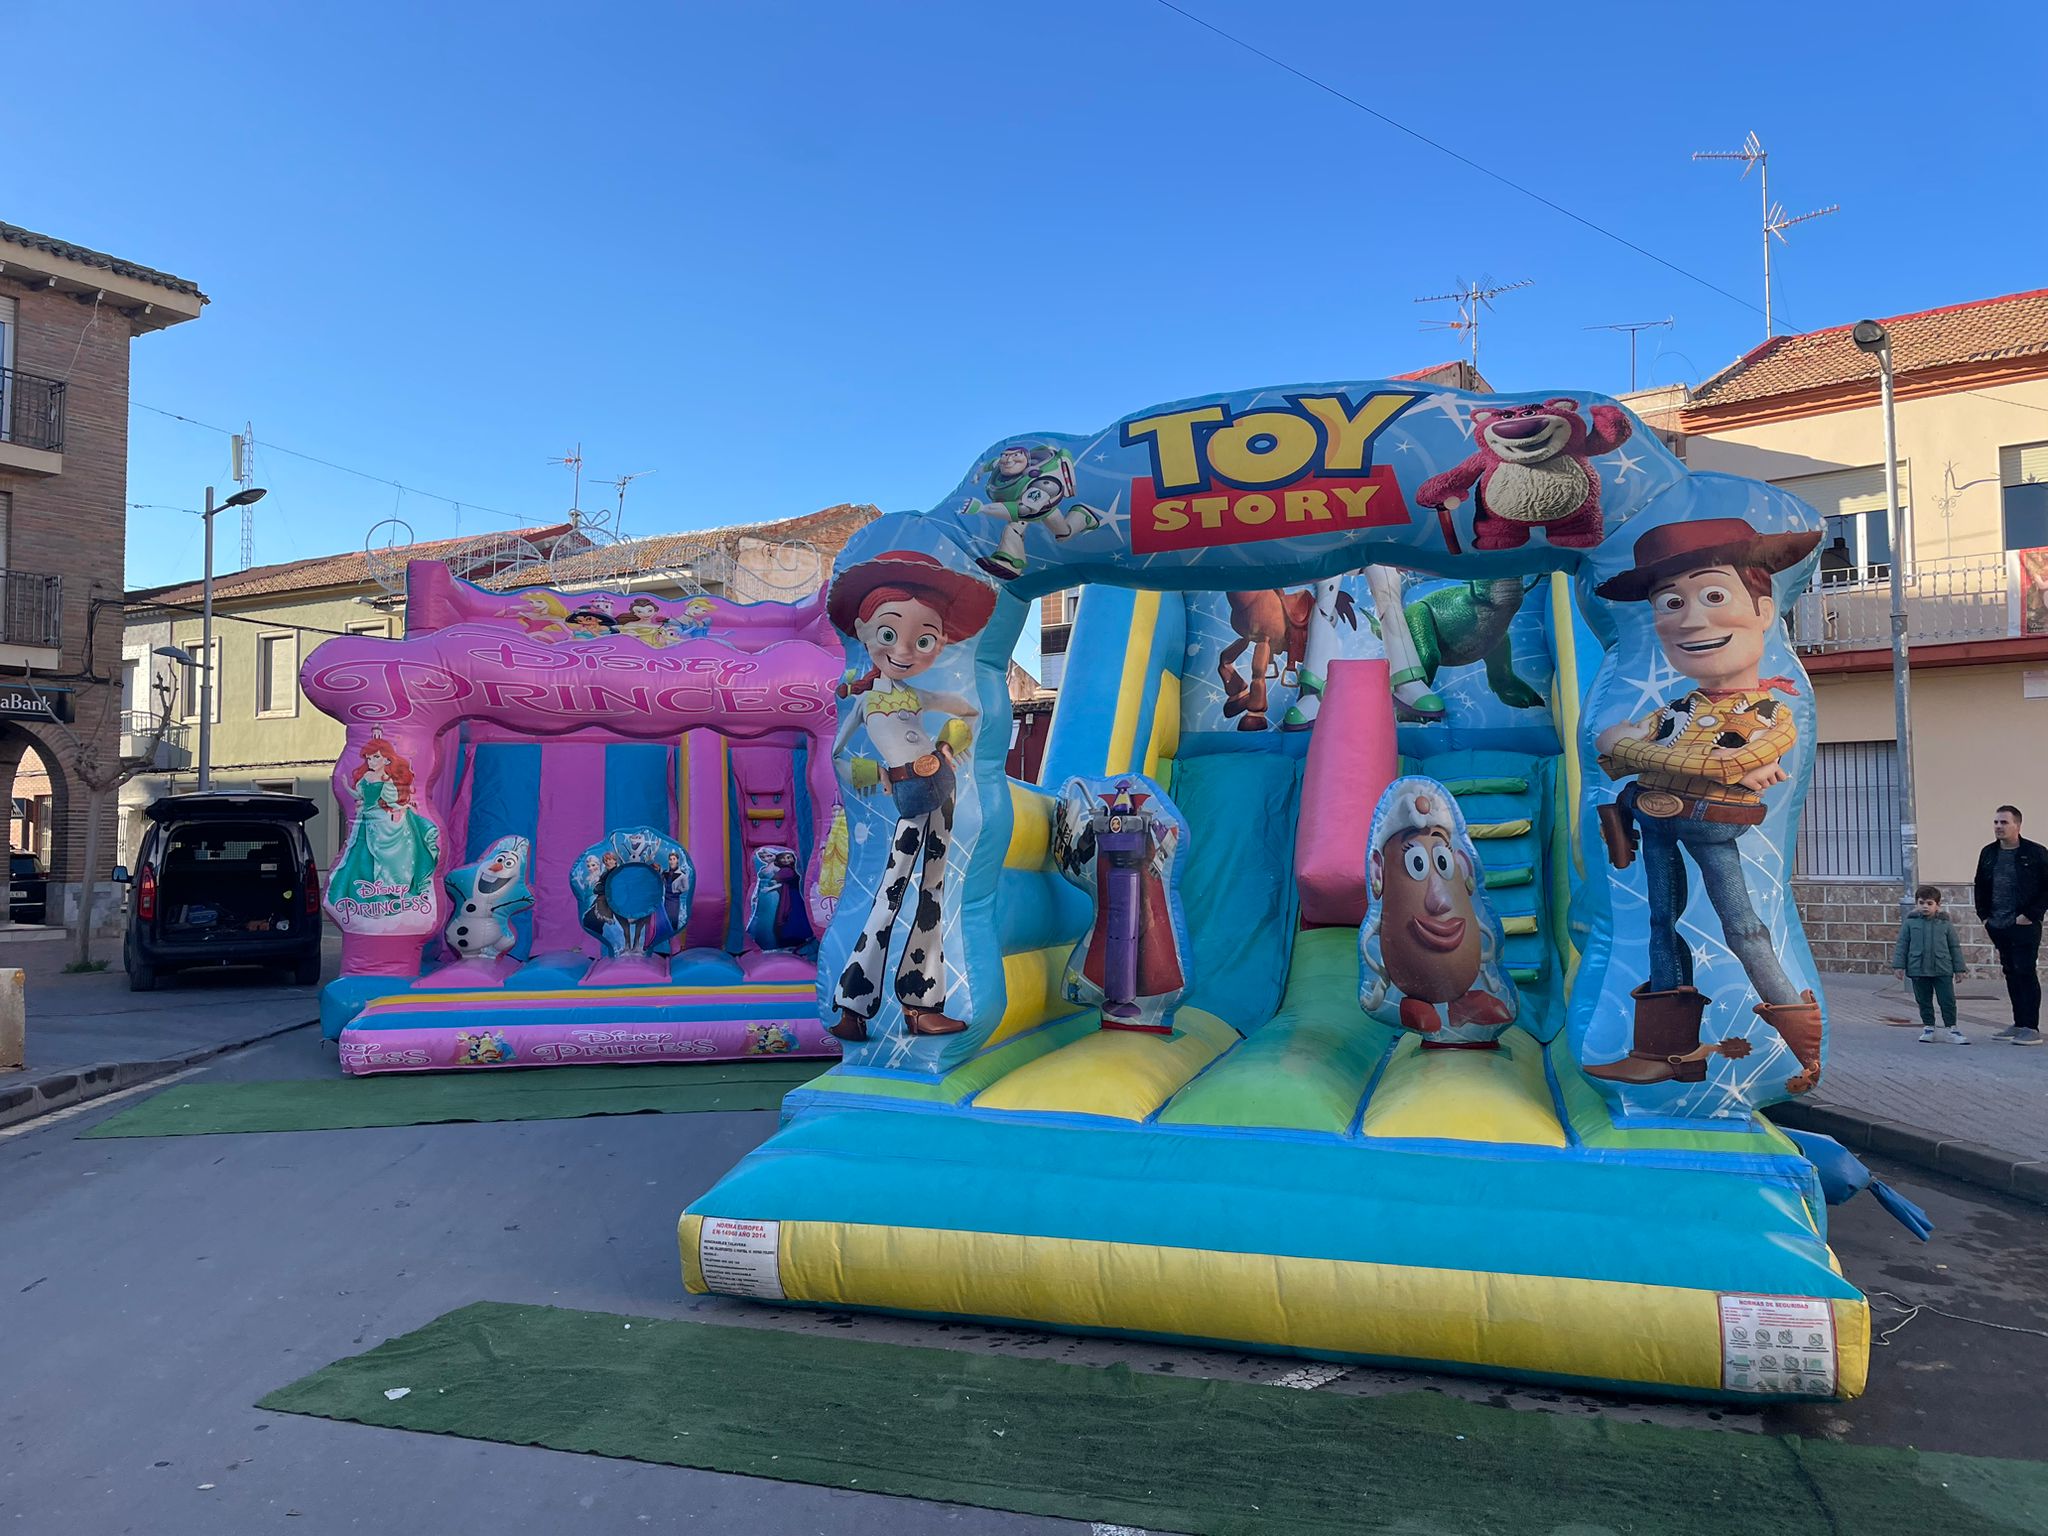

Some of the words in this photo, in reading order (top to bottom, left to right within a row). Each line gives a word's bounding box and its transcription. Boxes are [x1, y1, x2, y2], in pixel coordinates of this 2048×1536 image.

[1121, 391, 1429, 497] TOY
[1152, 485, 1380, 531] STORY
[335, 893, 432, 924] PRINCESS
[531, 1039, 717, 1062] PRINCESS
[716, 1222, 737, 1230] NORMA
[737, 1223, 764, 1232] EUROPEA
[738, 1230, 751, 1238] AÑO
